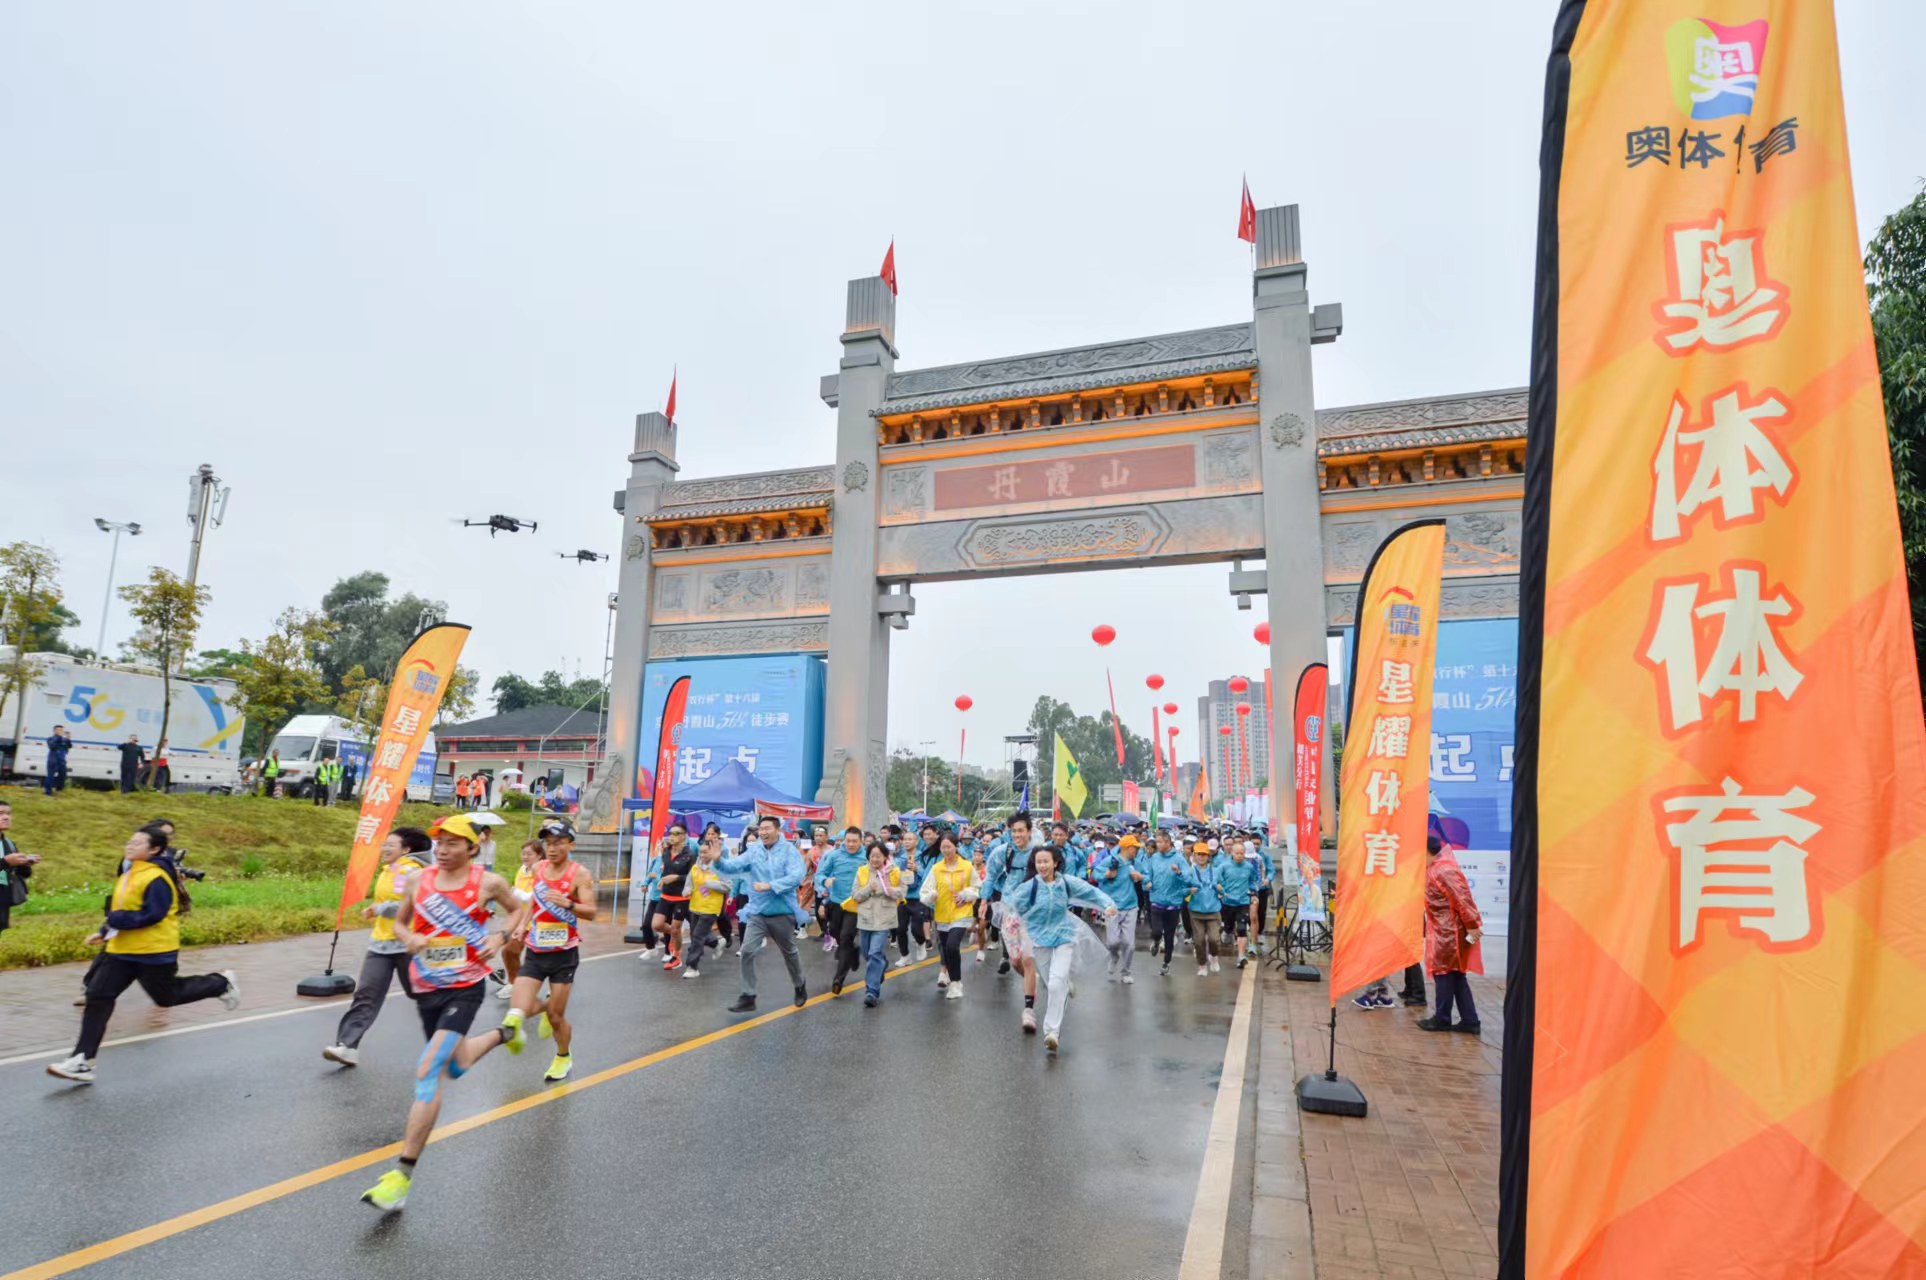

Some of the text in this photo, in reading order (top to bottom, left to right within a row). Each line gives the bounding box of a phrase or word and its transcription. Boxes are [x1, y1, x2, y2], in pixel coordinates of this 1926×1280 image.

[1689, 35, 1760, 103] 奥
[987, 459, 1130, 501] 丹霞山
[63, 684, 127, 732] 5G
[353, 704, 422, 845] 星耀体育
[1363, 659, 1416, 878] 星耀体育
